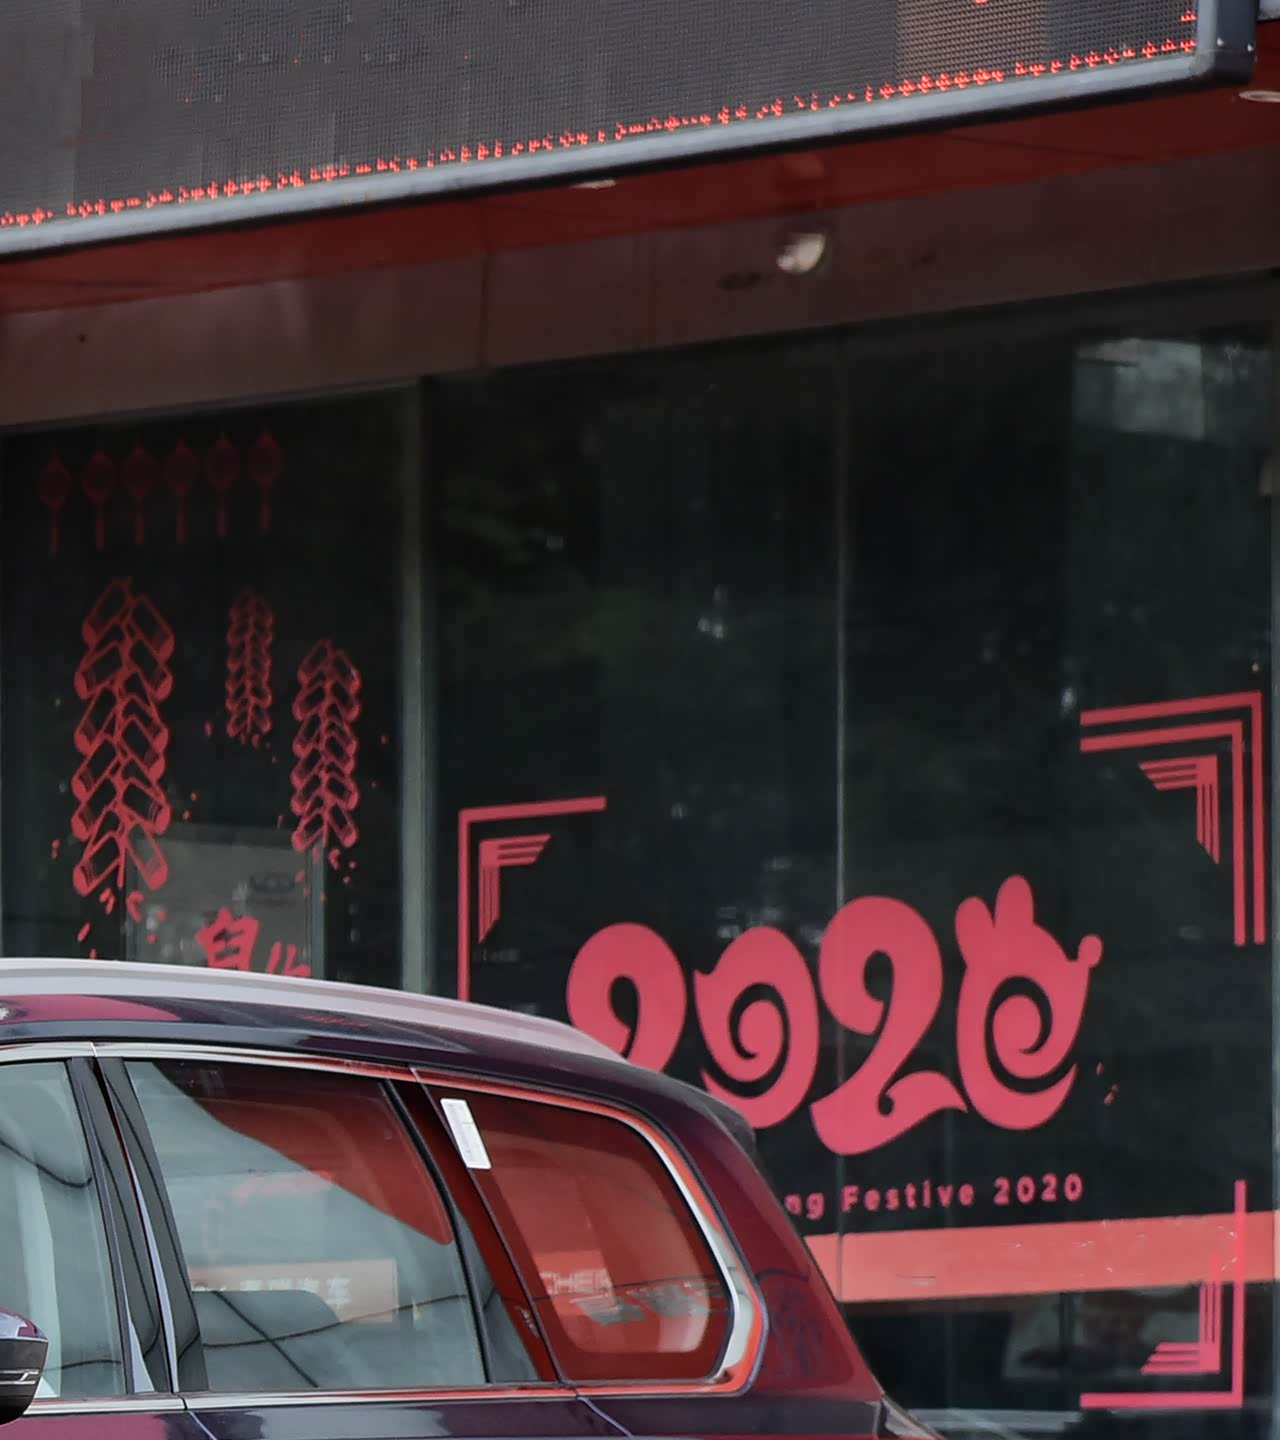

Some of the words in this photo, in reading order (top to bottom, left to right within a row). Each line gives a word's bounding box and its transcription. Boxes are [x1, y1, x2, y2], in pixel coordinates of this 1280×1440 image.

[566, 874, 1103, 1155] 2020
[841, 1179, 976, 1213] Festive
[993, 1172, 1083, 1205] 2020
